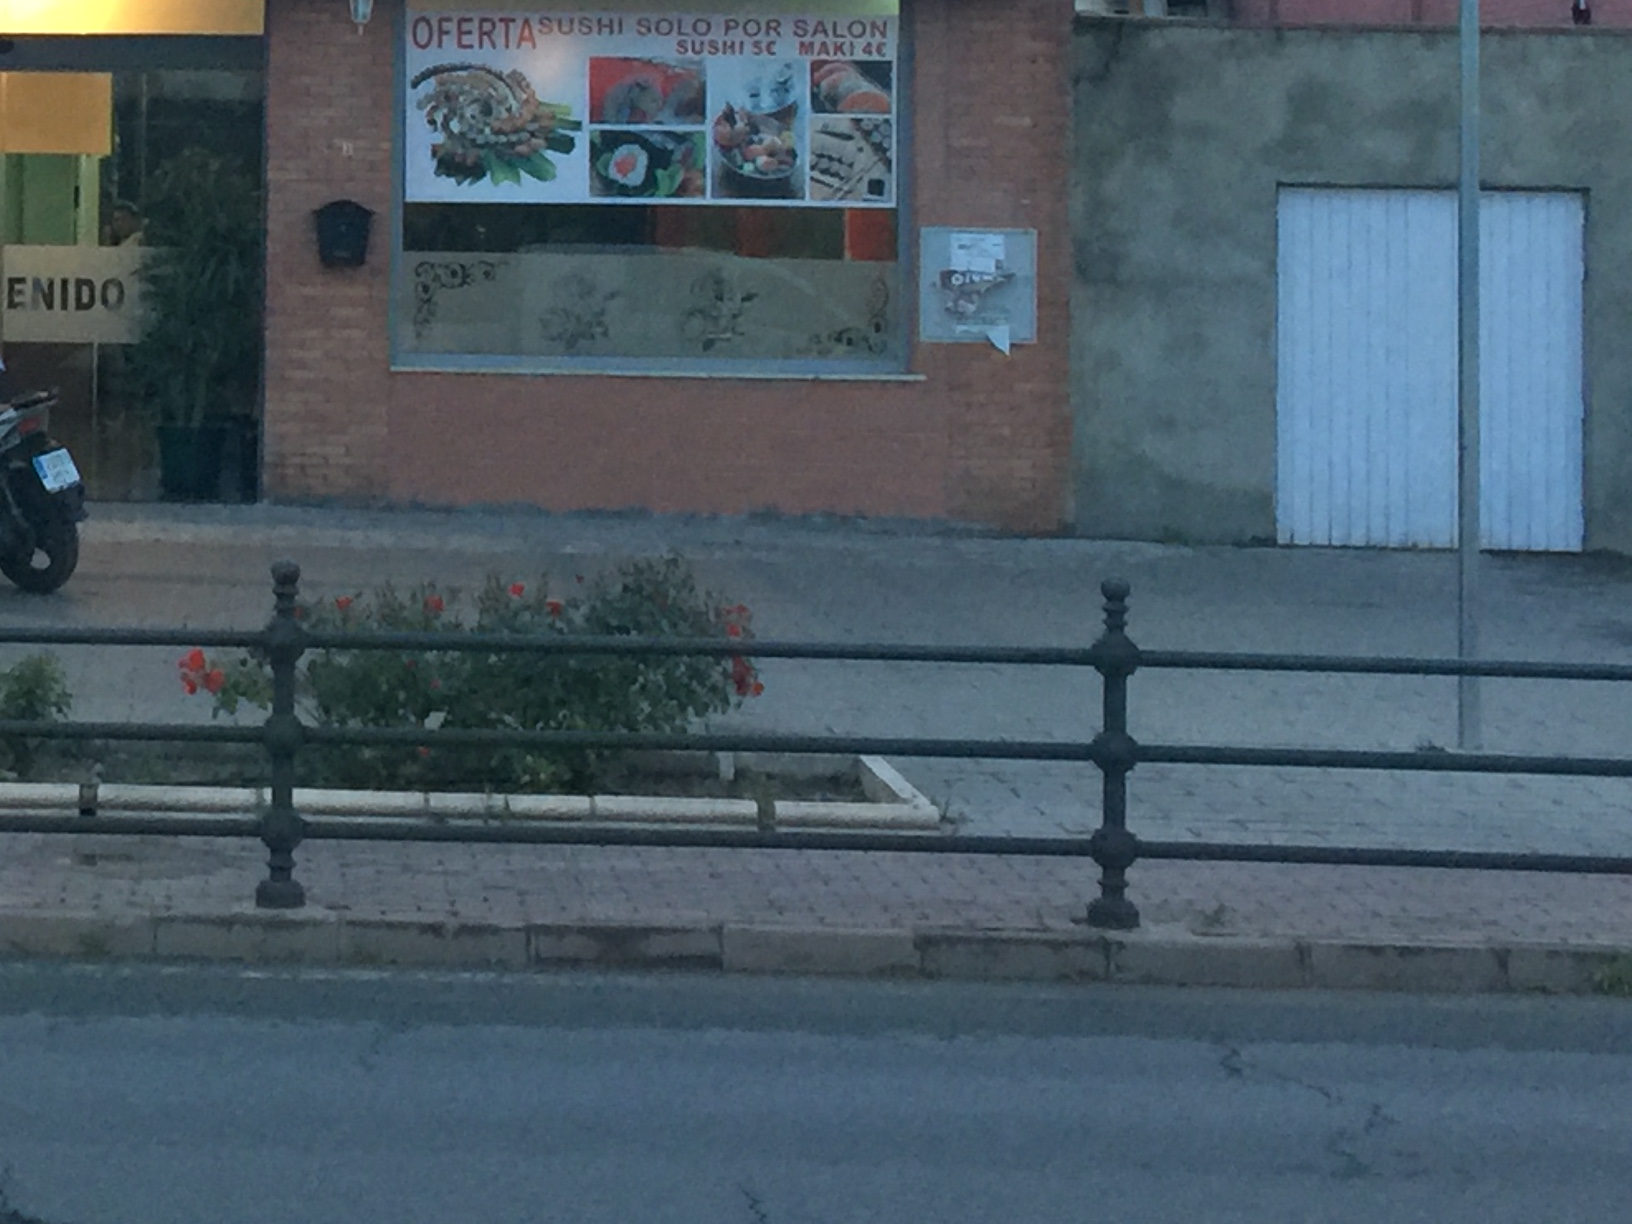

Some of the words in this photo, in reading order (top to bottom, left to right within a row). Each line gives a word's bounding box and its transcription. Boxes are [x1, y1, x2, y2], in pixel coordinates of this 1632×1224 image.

[411, 15, 538, 51] OFERTA
[537, 16, 624, 36] SUSHI
[635, 17, 712, 37] SOLO
[724, 18, 782, 38] POR
[792, 18, 888, 40] SALON
[675, 40, 744, 57] SUSHI
[798, 40, 855, 57] MAKI
